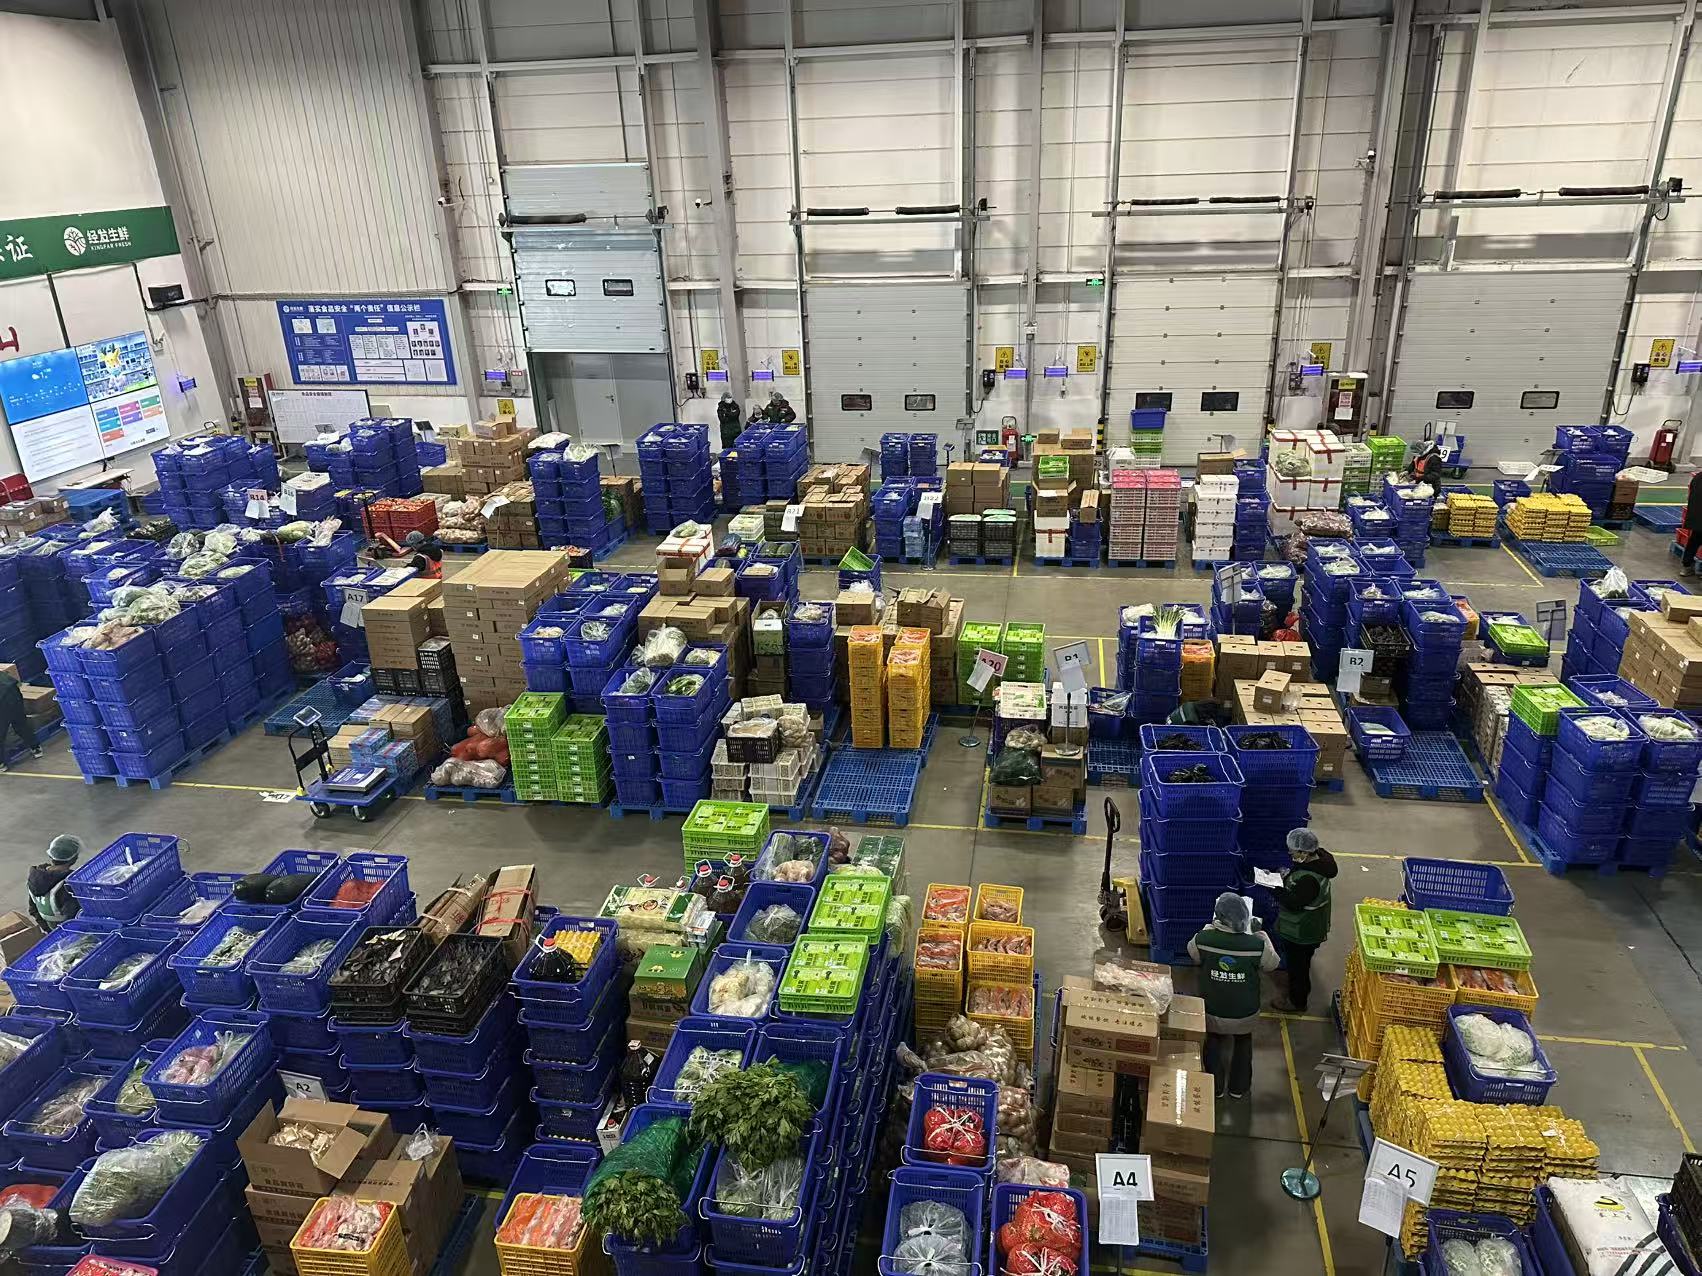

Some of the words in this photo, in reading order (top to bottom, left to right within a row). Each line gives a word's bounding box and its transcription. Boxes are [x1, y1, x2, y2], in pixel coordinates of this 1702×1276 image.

[87, 226, 130, 244] 经发生鲜
[0, 235, 34, 262] 证
[91, 243, 114, 251] KINGFAR
[347, 593, 364, 602] A17
[1349, 656, 1364, 667] B2
[1210, 969, 1246, 980] 经发生鲜
[296, 1082, 311, 1093] A2
[1112, 1171, 1138, 1187] A4
[1387, 1163, 1417, 1188] A5
